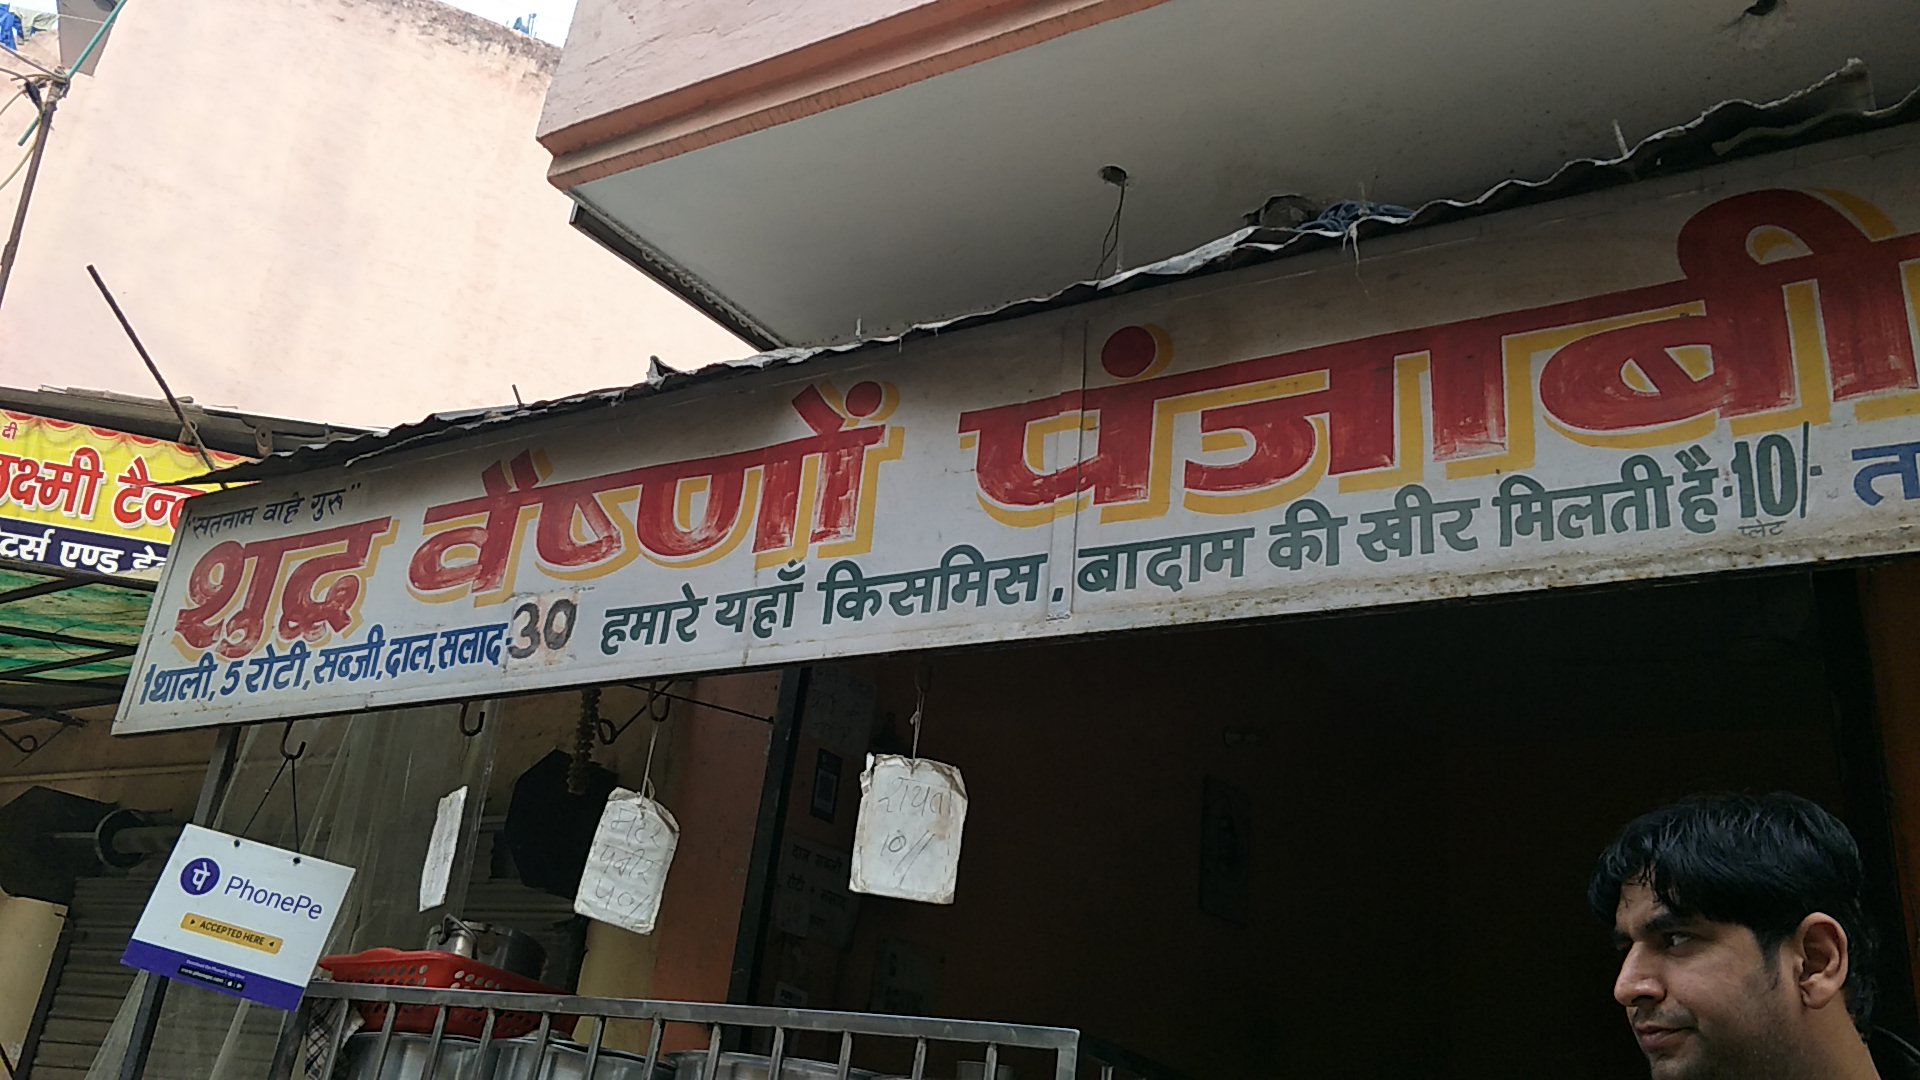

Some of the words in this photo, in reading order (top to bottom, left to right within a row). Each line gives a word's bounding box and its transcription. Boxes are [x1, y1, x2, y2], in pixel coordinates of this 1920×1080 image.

[60, 541, 125, 573] एण्ड
[601, 582, 708, 655] हमारे
[1077, 527, 1256, 592] बादाम
[1268, 499, 1348, 570] की
[1356, 484, 1480, 562] खीर
[1491, 454, 1674, 547] मिलती
[224, 876, 322, 920] PhonePe
[200, 921, 242, 939] ACCEPTED
[242, 933, 265, 946] HERE
